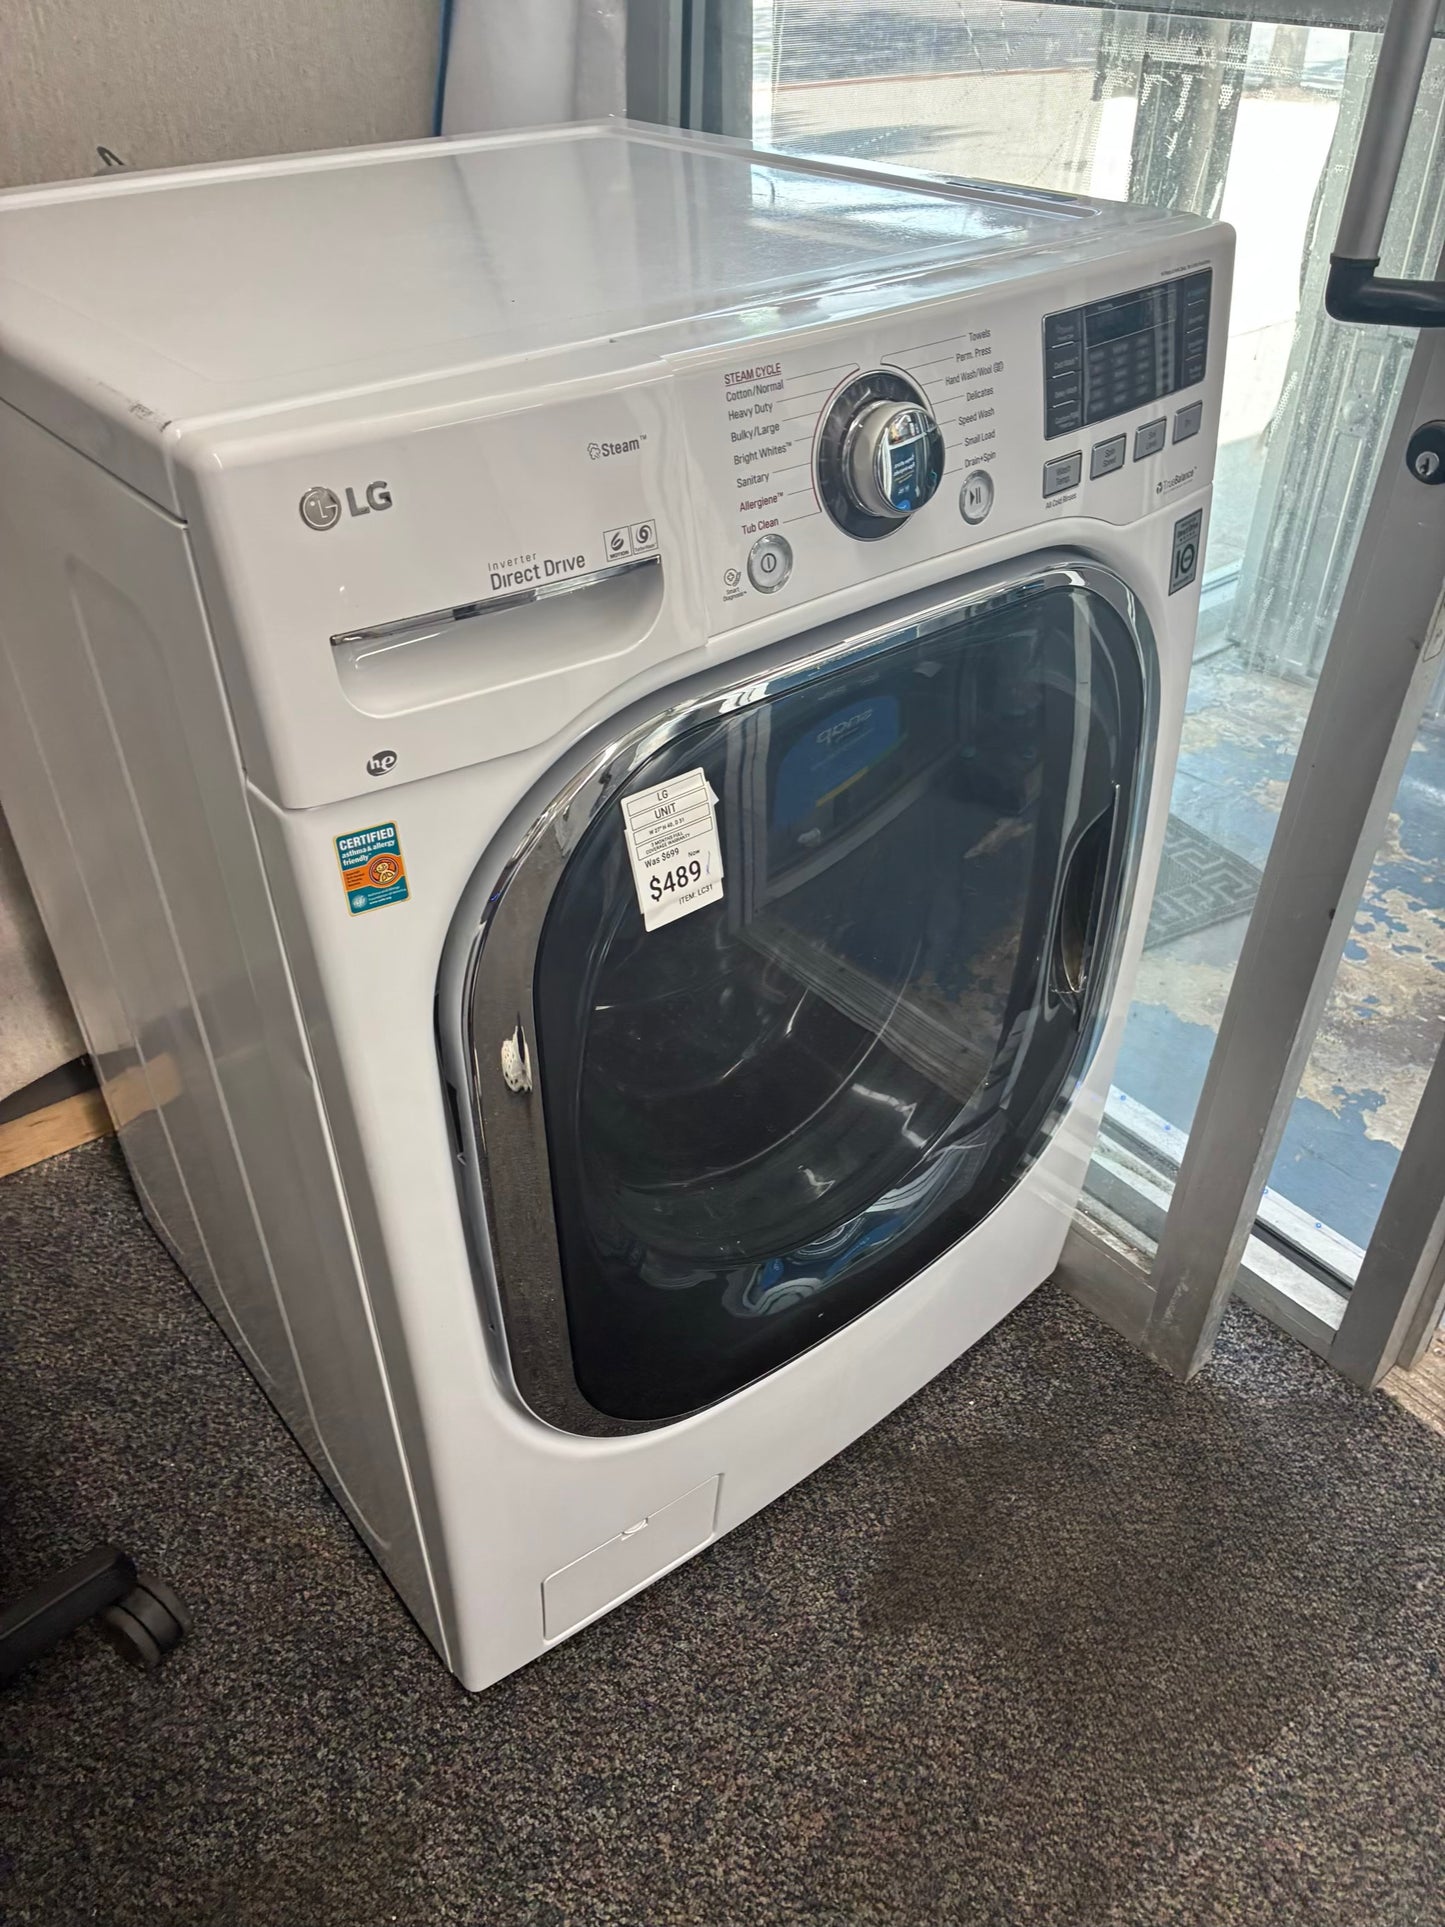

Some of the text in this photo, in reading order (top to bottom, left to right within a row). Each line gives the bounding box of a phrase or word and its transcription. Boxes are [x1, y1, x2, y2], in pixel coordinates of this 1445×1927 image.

[968, 329, 991, 341] Towels
[975, 346, 992, 358] Press
[724, 363, 782, 385] STEAM CYCLE
[945, 373, 960, 386] Hand
[726, 379, 784, 402] Cotton/Normal
[966, 387, 994, 401] Delicates
[728, 402, 773, 421] Heavy Duty
[958, 407, 995, 426] Speed Wash
[730, 423, 780, 443] Bulky/Large
[964, 428, 996, 447] Small Load
[734, 451, 758, 465] Bright
[736, 473, 770, 488] Sanitary
[345, 480, 393, 517] LG
[741, 518, 779, 535] Tub Clean
[487, 553, 537, 572] Inverter
[490, 554, 586, 591] Direct Drive
[656, 789, 669, 801] LG
[654, 802, 677, 819] UNIT
[340, 827, 395, 851] CERTIFIED
[341, 839, 396, 859] asthma & allergy
[644, 847, 700, 868] Was $699 Now
[649, 860, 702, 903] $489
[697, 883, 713, 896] LC31
